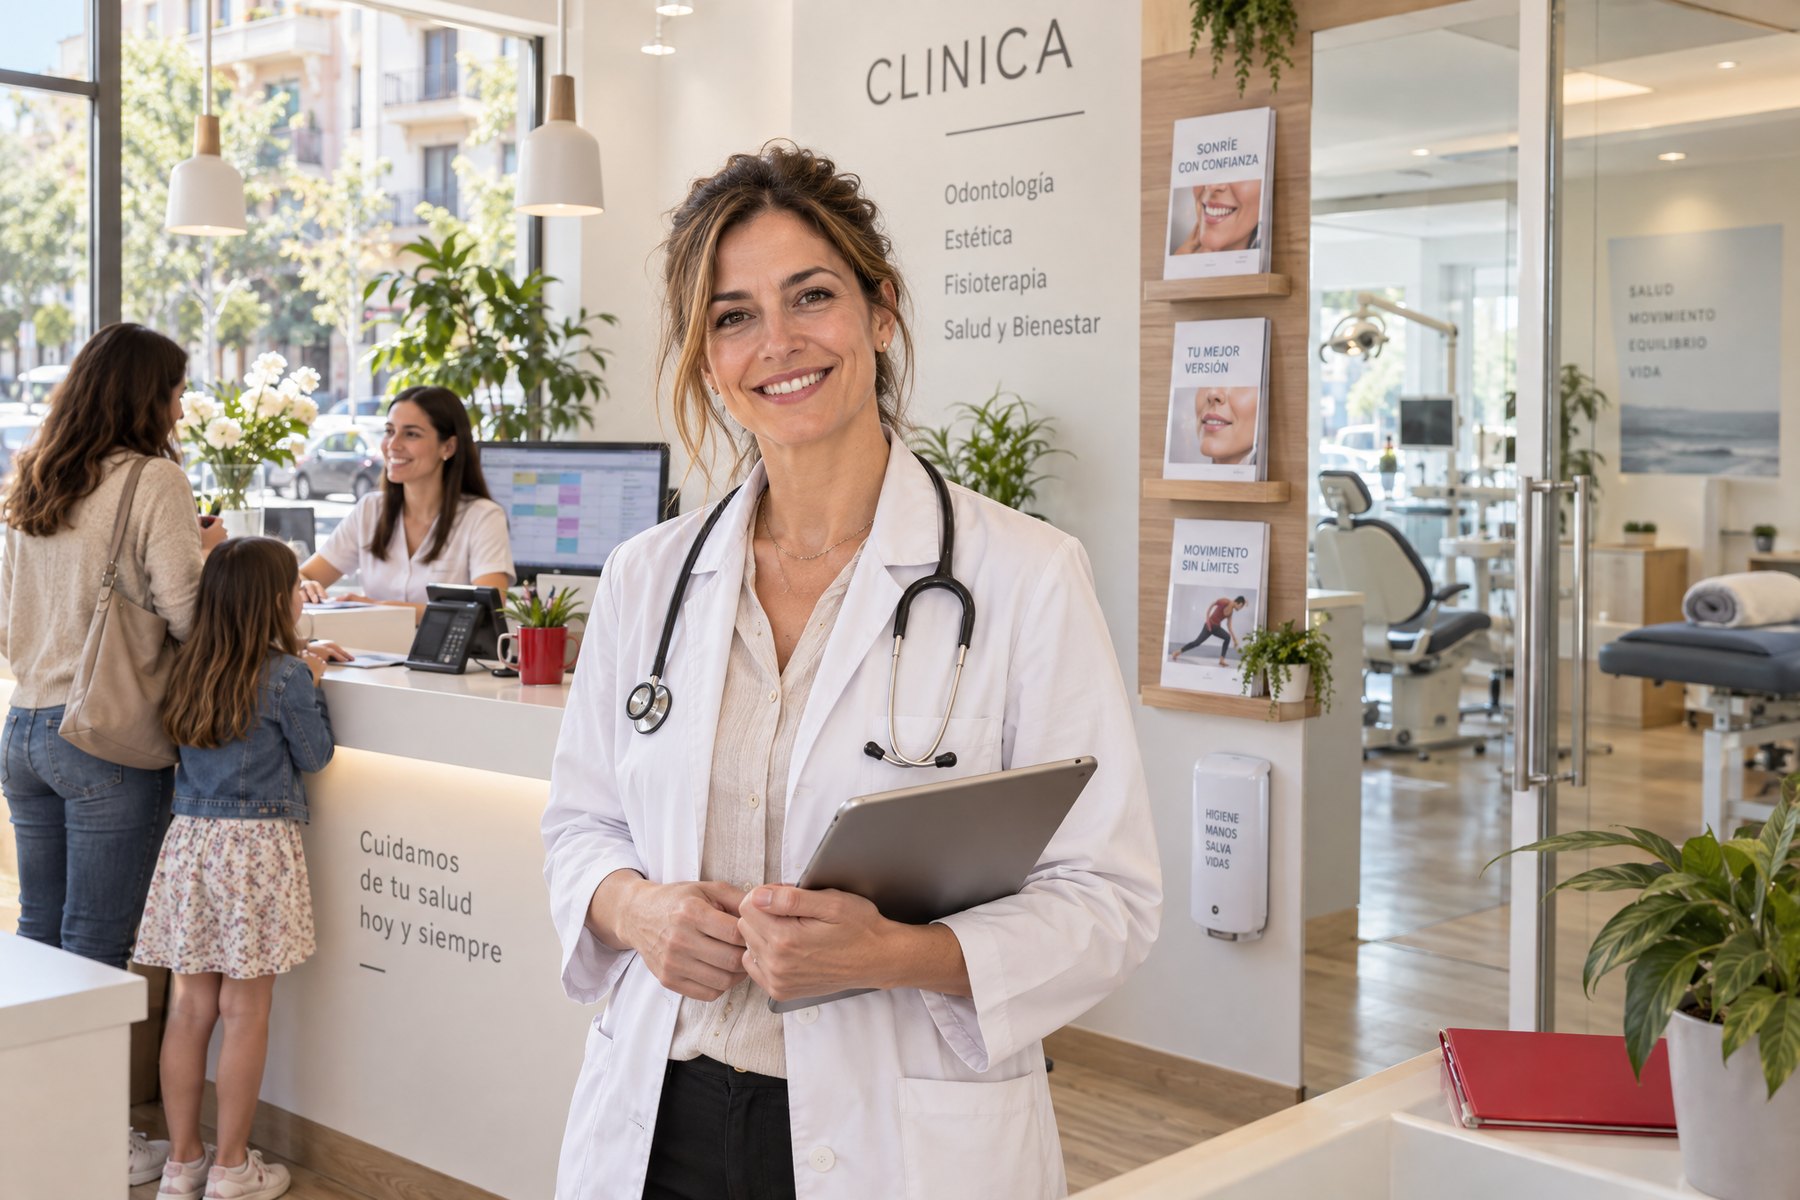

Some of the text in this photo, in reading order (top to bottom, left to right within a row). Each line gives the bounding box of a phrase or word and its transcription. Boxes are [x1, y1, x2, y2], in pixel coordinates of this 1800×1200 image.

[866, 18, 1073, 106] CLINICA
[1196, 137, 1238, 156] SONRÍE
[1178, 153, 1259, 174] CON CONFIANZA
[944, 171, 1054, 205] Odontología
[945, 225, 1013, 250] Estética
[945, 267, 1047, 296] Fisioterapia
[1630, 284, 1673, 298] SALUD
[1629, 309, 1715, 324] MOVIMIENTO
[944, 314, 1101, 344] Salud y Bienestar
[1187, 345, 1240, 358] TU MEJOR
[1629, 337, 1707, 351] EQUILIBRIO
[1185, 359, 1229, 374] VERSIÓN
[1629, 366, 1661, 378] VIDA
[1183, 544, 1249, 559] MOVIMIENTO
[1181, 558, 1240, 574] SIN LÍMITES
[1205, 808, 1239, 824] HIGIENE
[1205, 824, 1238, 840] MANOS
[360, 830, 460, 873] Cuidamos
[1205, 840, 1232, 855] SALVA
[1205, 855, 1230, 870] VIDAS
[360, 868, 472, 916] de tu salud
[360, 904, 502, 963] hoy y siempre
